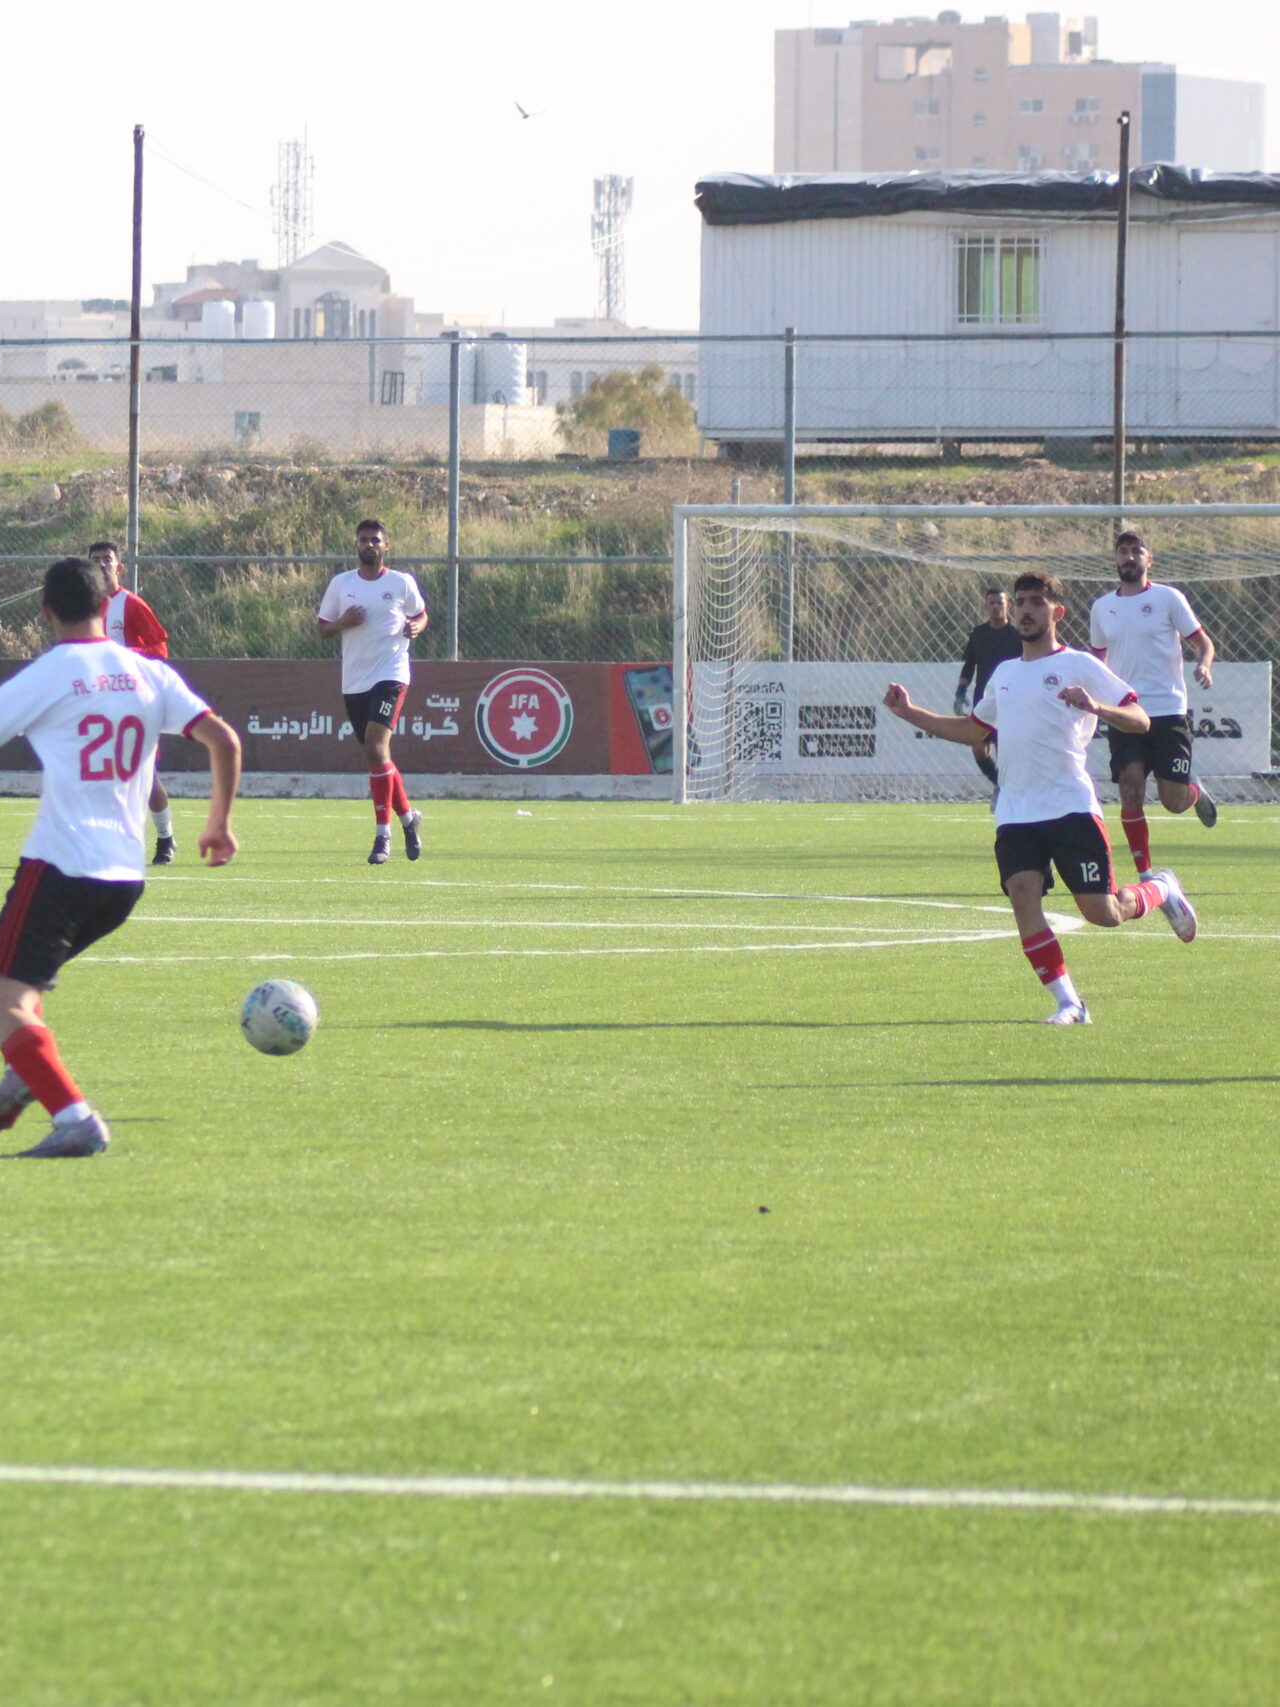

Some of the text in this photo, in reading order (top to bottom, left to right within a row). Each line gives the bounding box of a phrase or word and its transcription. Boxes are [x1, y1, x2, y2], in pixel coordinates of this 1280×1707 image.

[379, 701, 392, 716] 15
[426, 694, 460, 712] بيت
[509, 694, 540, 710] JFA
[247, 711, 333, 741] الأردنية
[412, 716, 460, 741] كرة
[78, 714, 145, 782] 20
[1172, 758, 1190, 775] 30
[1080, 861, 1101, 883] 12
